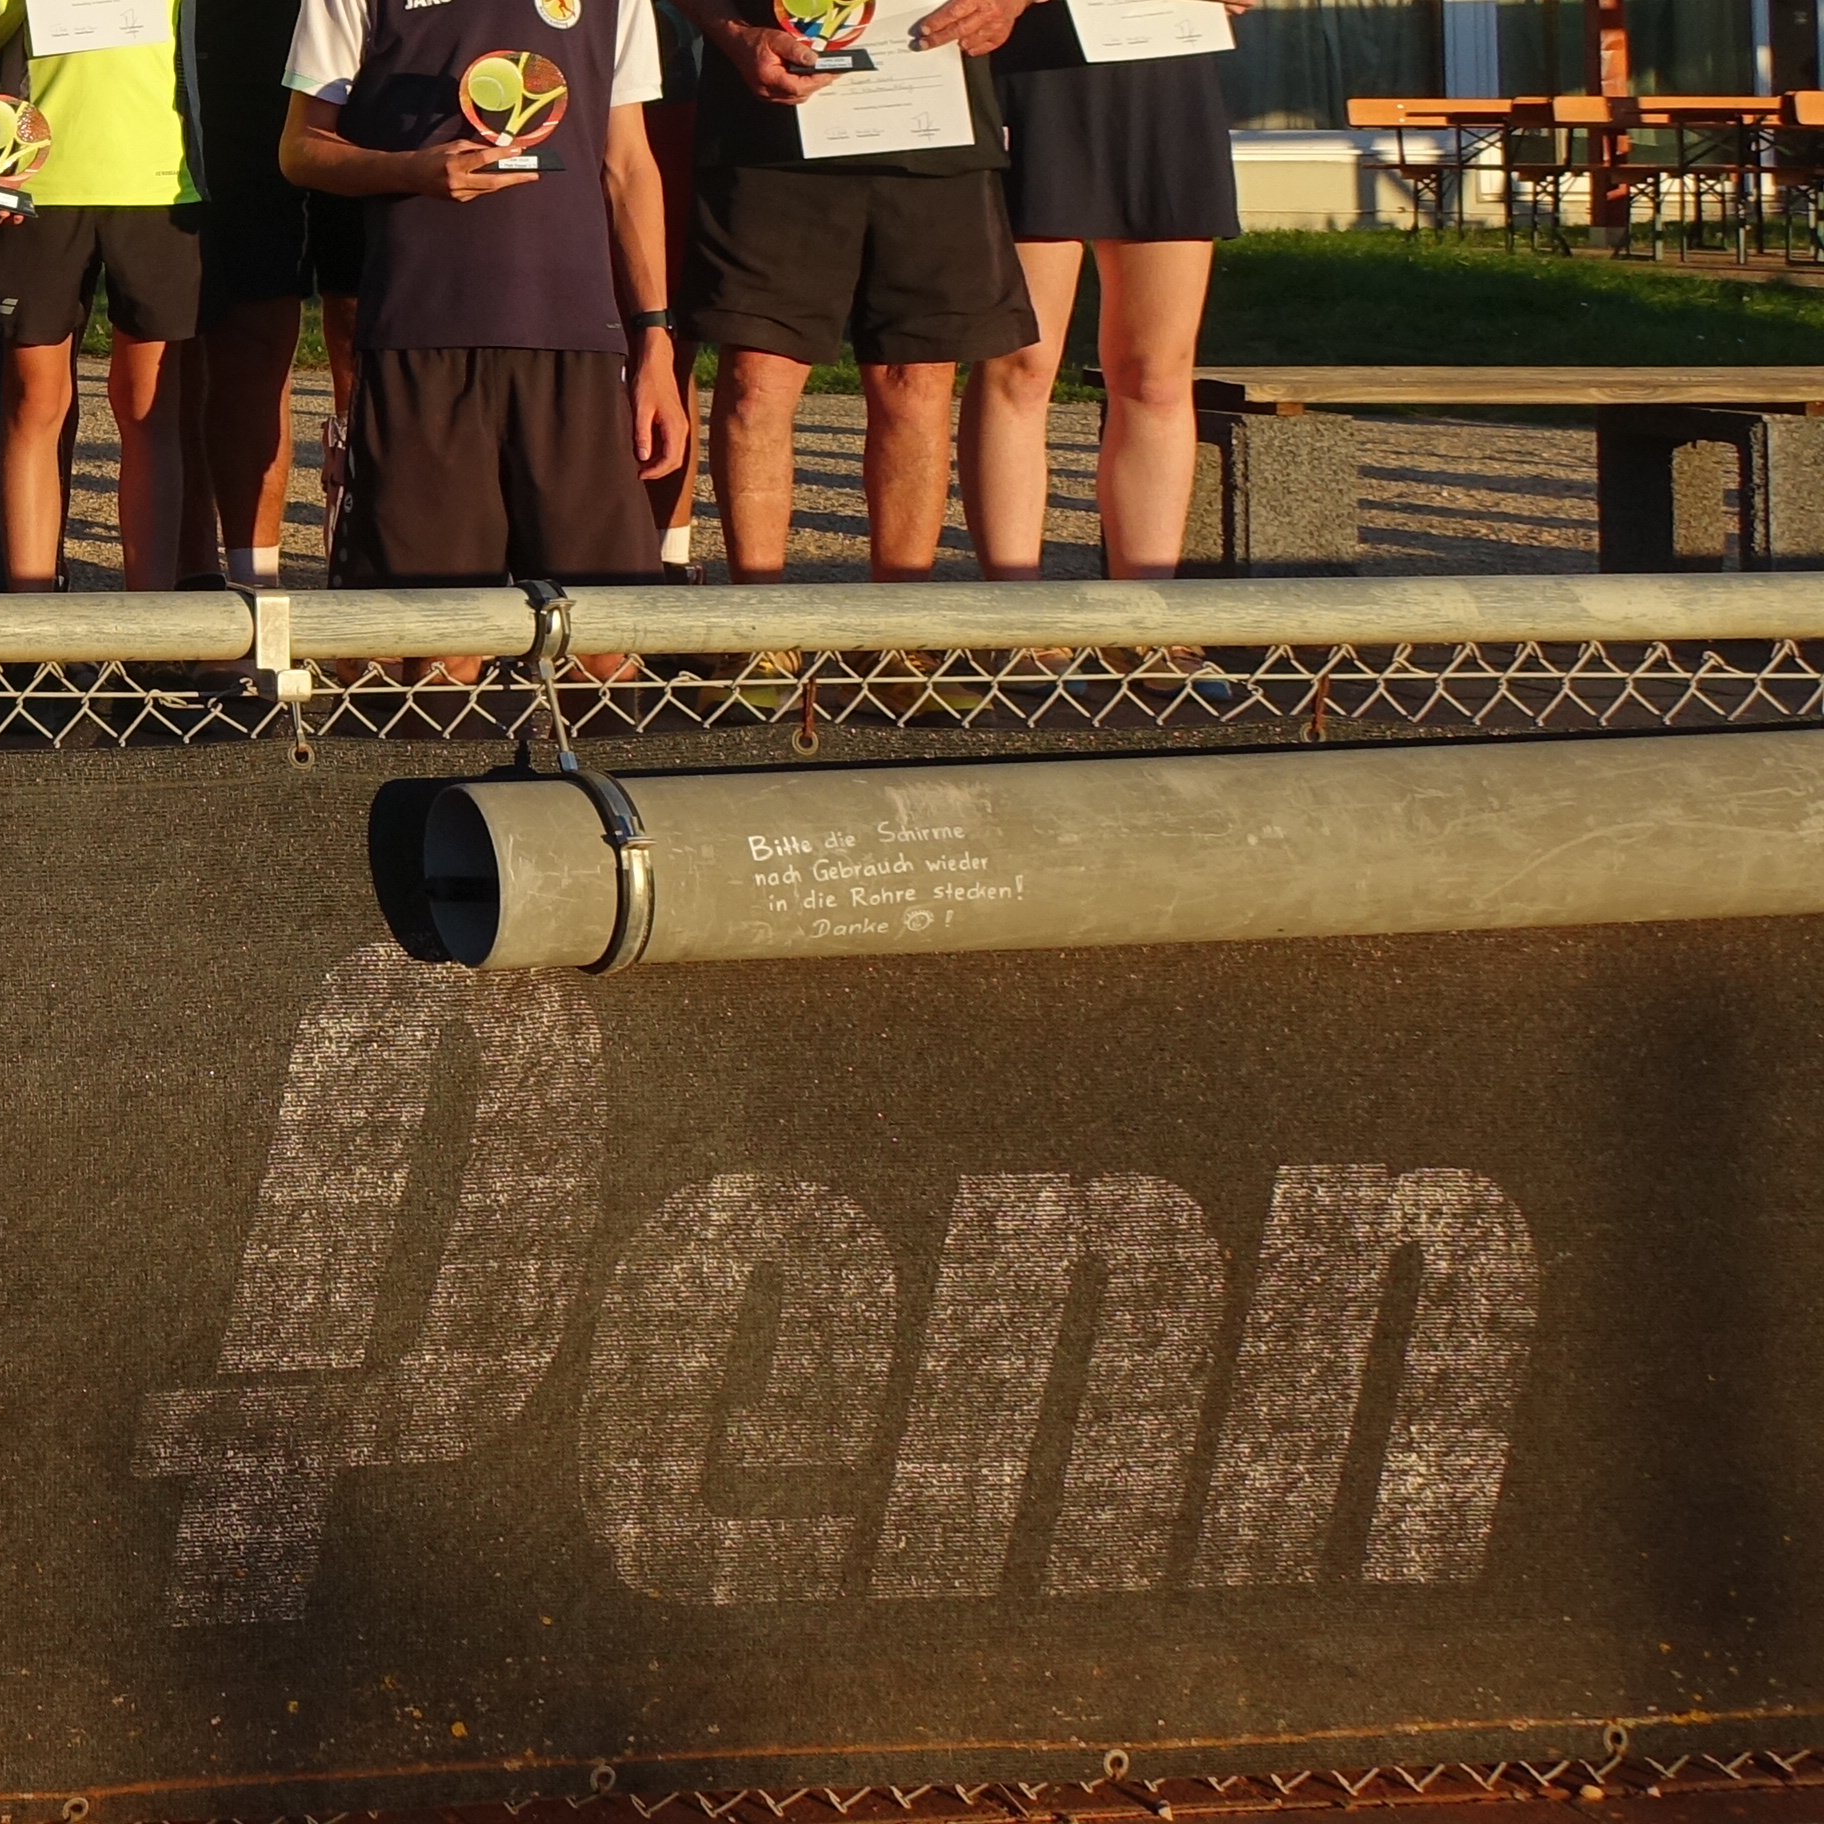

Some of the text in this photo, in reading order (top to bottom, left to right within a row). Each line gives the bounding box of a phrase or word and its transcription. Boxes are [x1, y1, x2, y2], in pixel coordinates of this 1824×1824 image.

[748, 821, 966, 861] Bitte die Schirme
[754, 851, 989, 887] nach Gebrauch wieder
[769, 875, 1024, 912] in die Rohre stecken!
[810, 918, 889, 939] Danke
[132, 941, 1539, 1628] Penn
